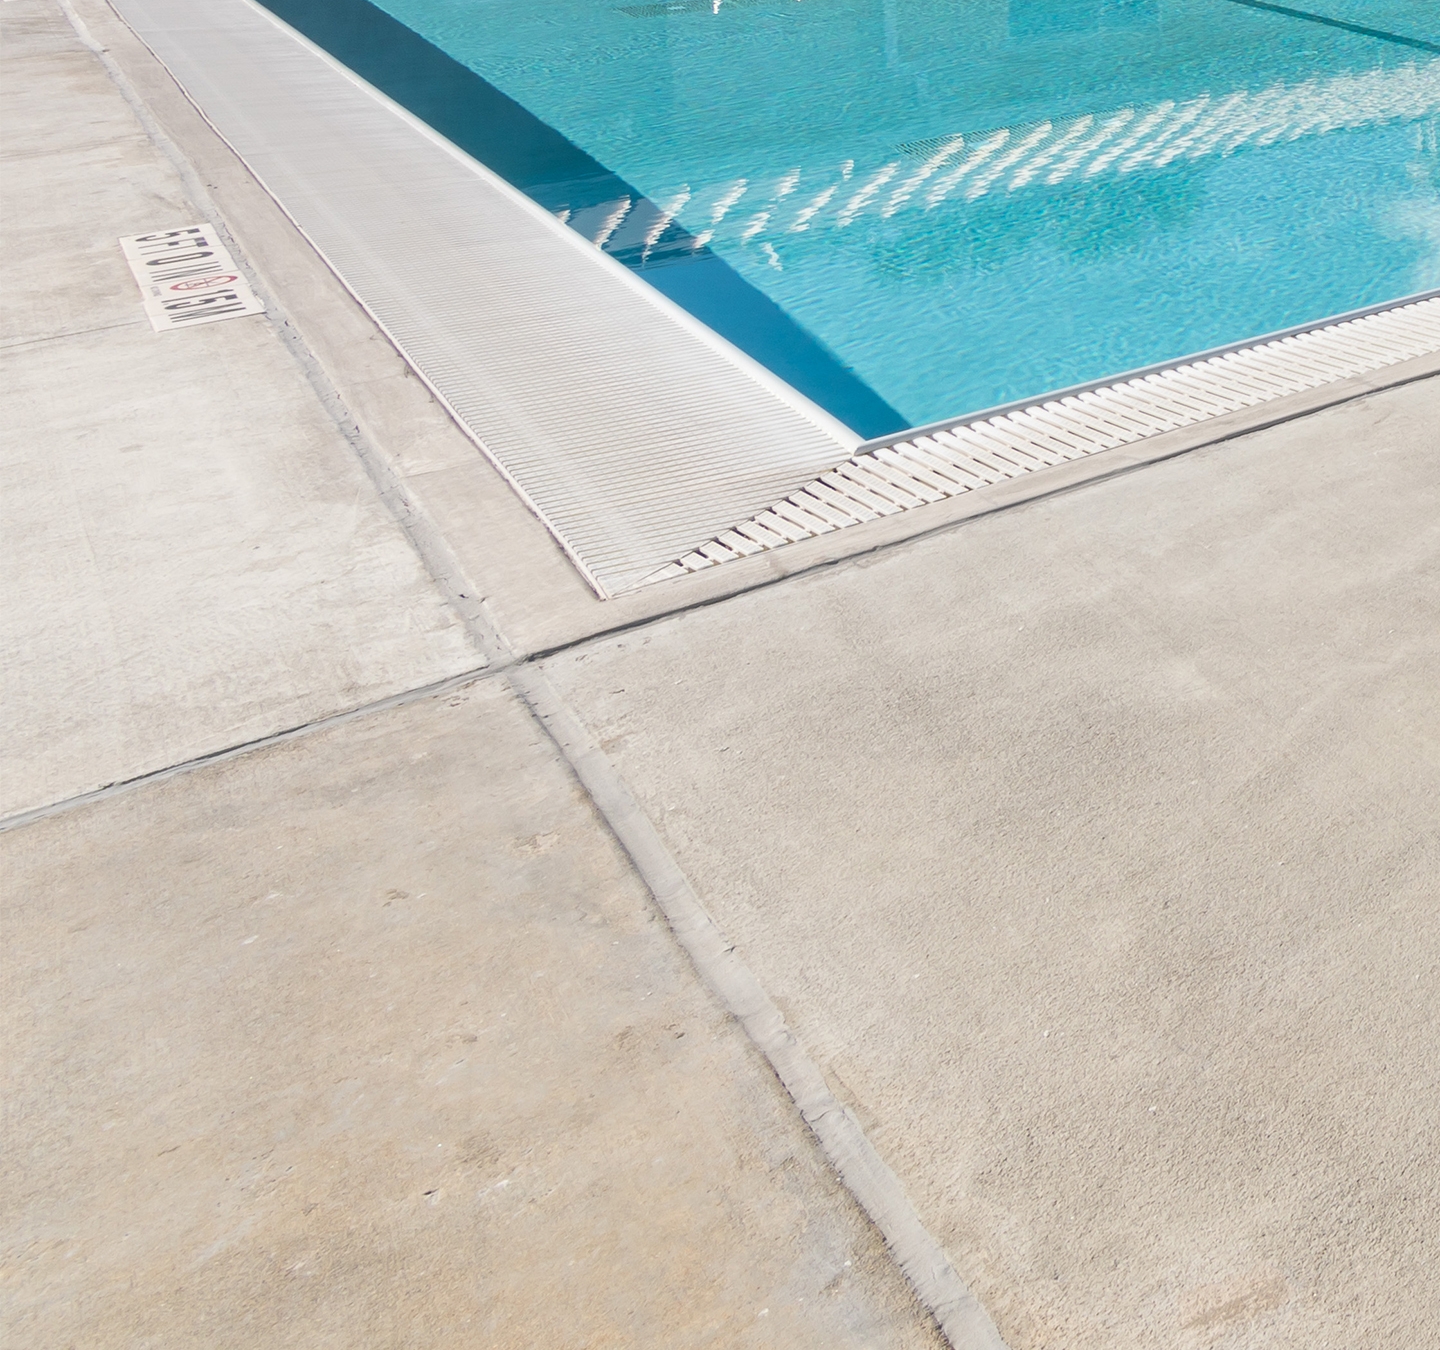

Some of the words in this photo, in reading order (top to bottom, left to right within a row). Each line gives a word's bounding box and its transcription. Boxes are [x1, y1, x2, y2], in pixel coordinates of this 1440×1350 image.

[135, 228, 200, 242] 5
[138, 237, 209, 255] FT
[149, 261, 224, 282] IN
[168, 302, 246, 323] M
